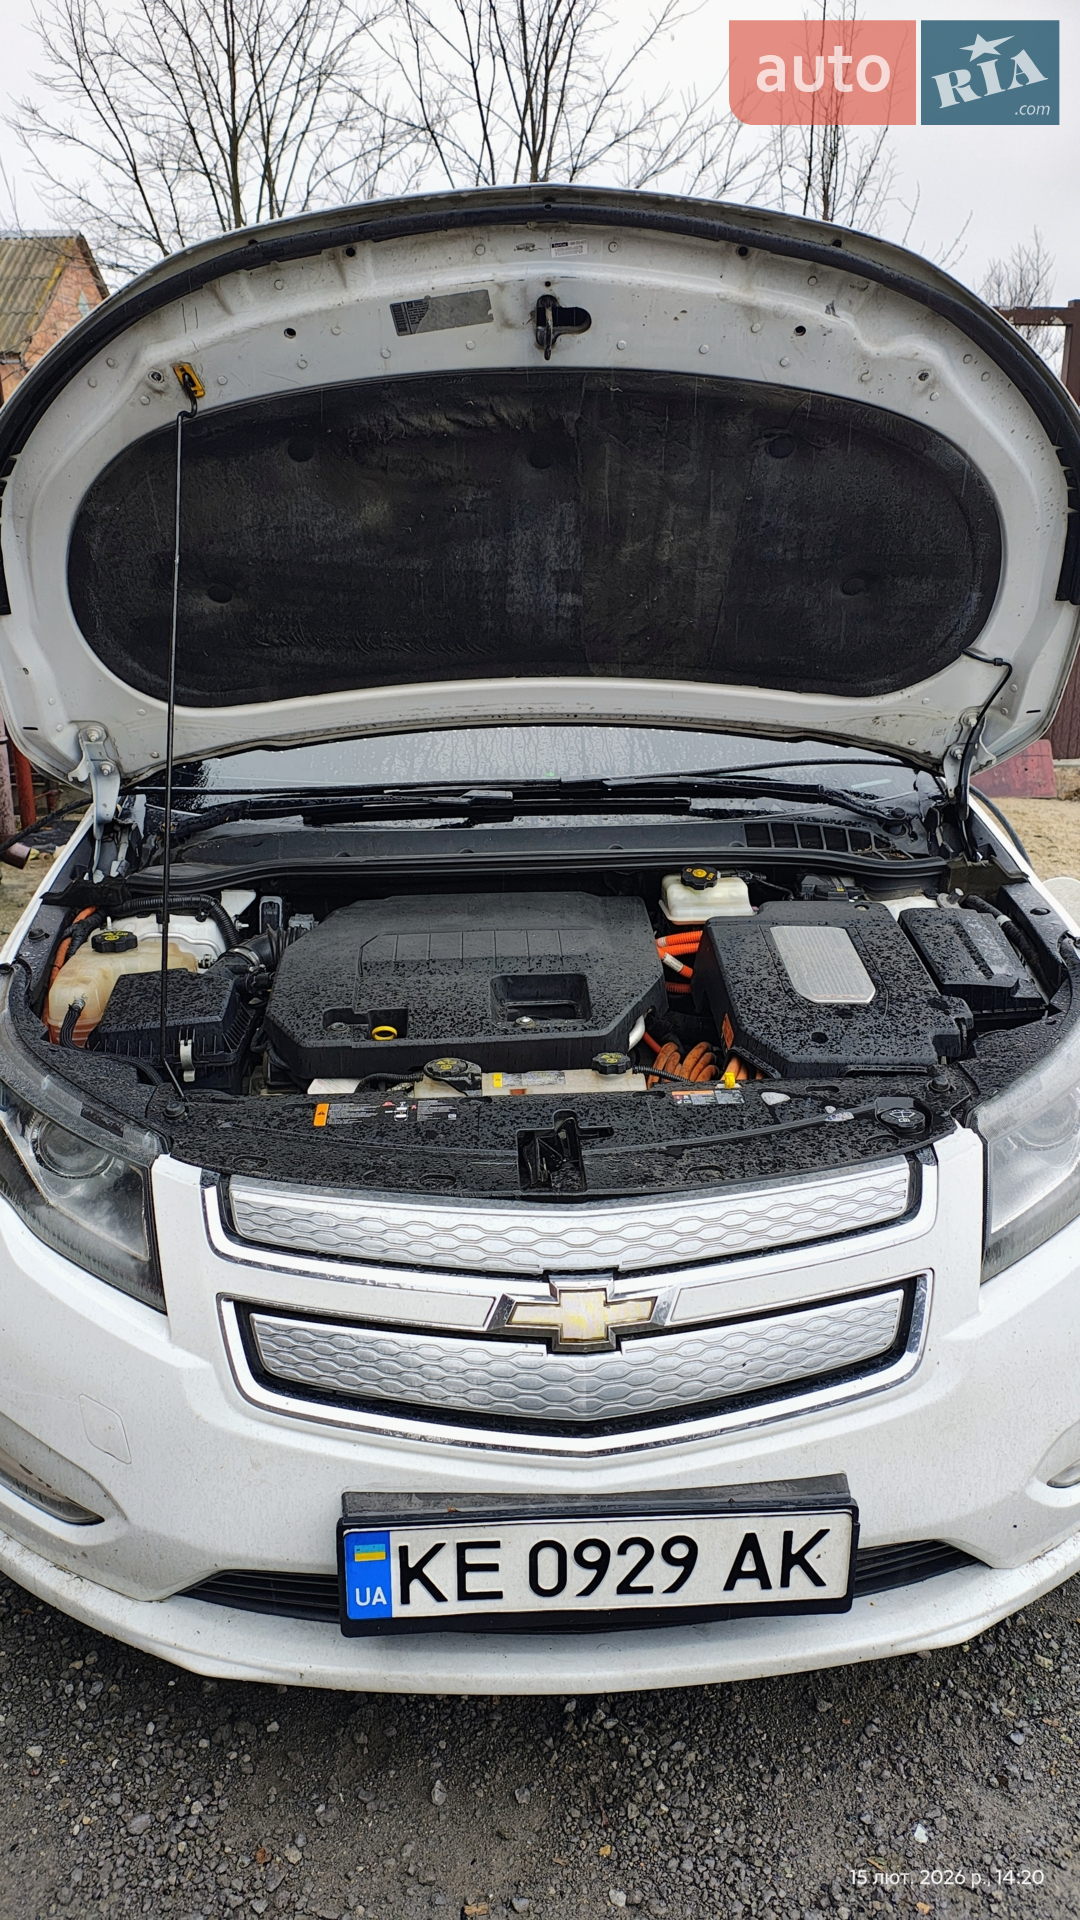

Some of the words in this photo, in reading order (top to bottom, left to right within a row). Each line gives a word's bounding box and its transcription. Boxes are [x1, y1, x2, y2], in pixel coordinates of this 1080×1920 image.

[399, 1540, 503, 1605] KE
[528, 1535, 698, 1597] 0929
[723, 1528, 831, 1591] AK
[355, 1586, 387, 1605] UA
